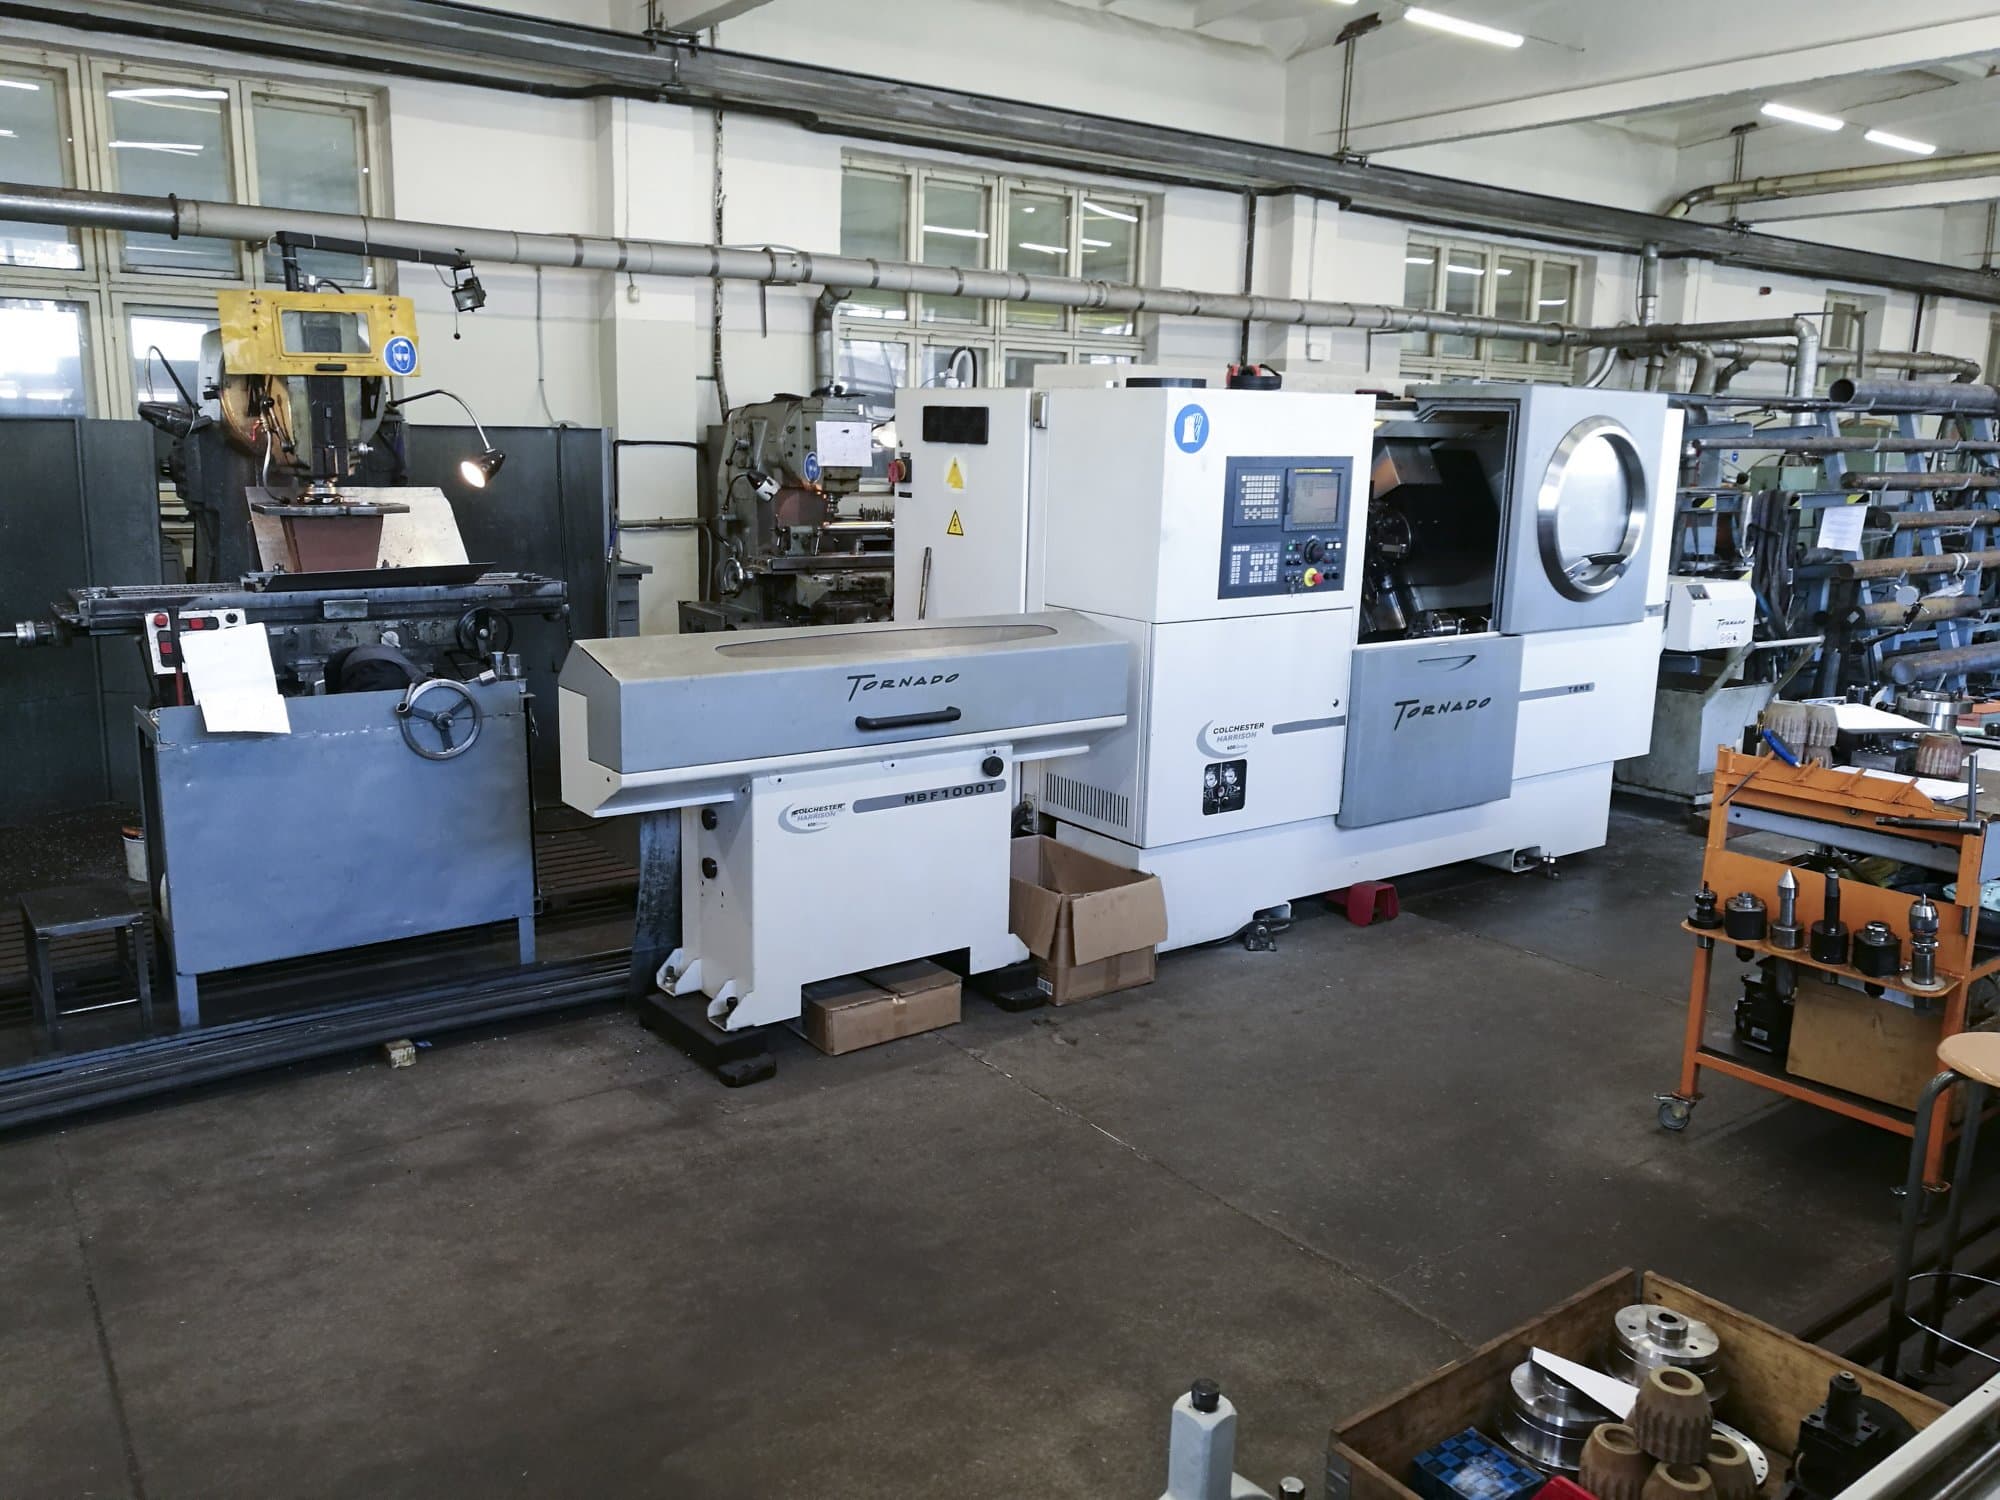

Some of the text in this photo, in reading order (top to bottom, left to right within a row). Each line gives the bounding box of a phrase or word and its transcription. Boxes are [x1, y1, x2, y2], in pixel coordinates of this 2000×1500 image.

[847, 673, 960, 702] TORNADO
[1394, 697, 1492, 731] TORNADO
[1213, 722, 1265, 735] COLCHESTER
[1217, 732, 1257, 742] HARRISON
[904, 783, 997, 804] MBF1000T
[797, 811, 837, 821] HARRISON
